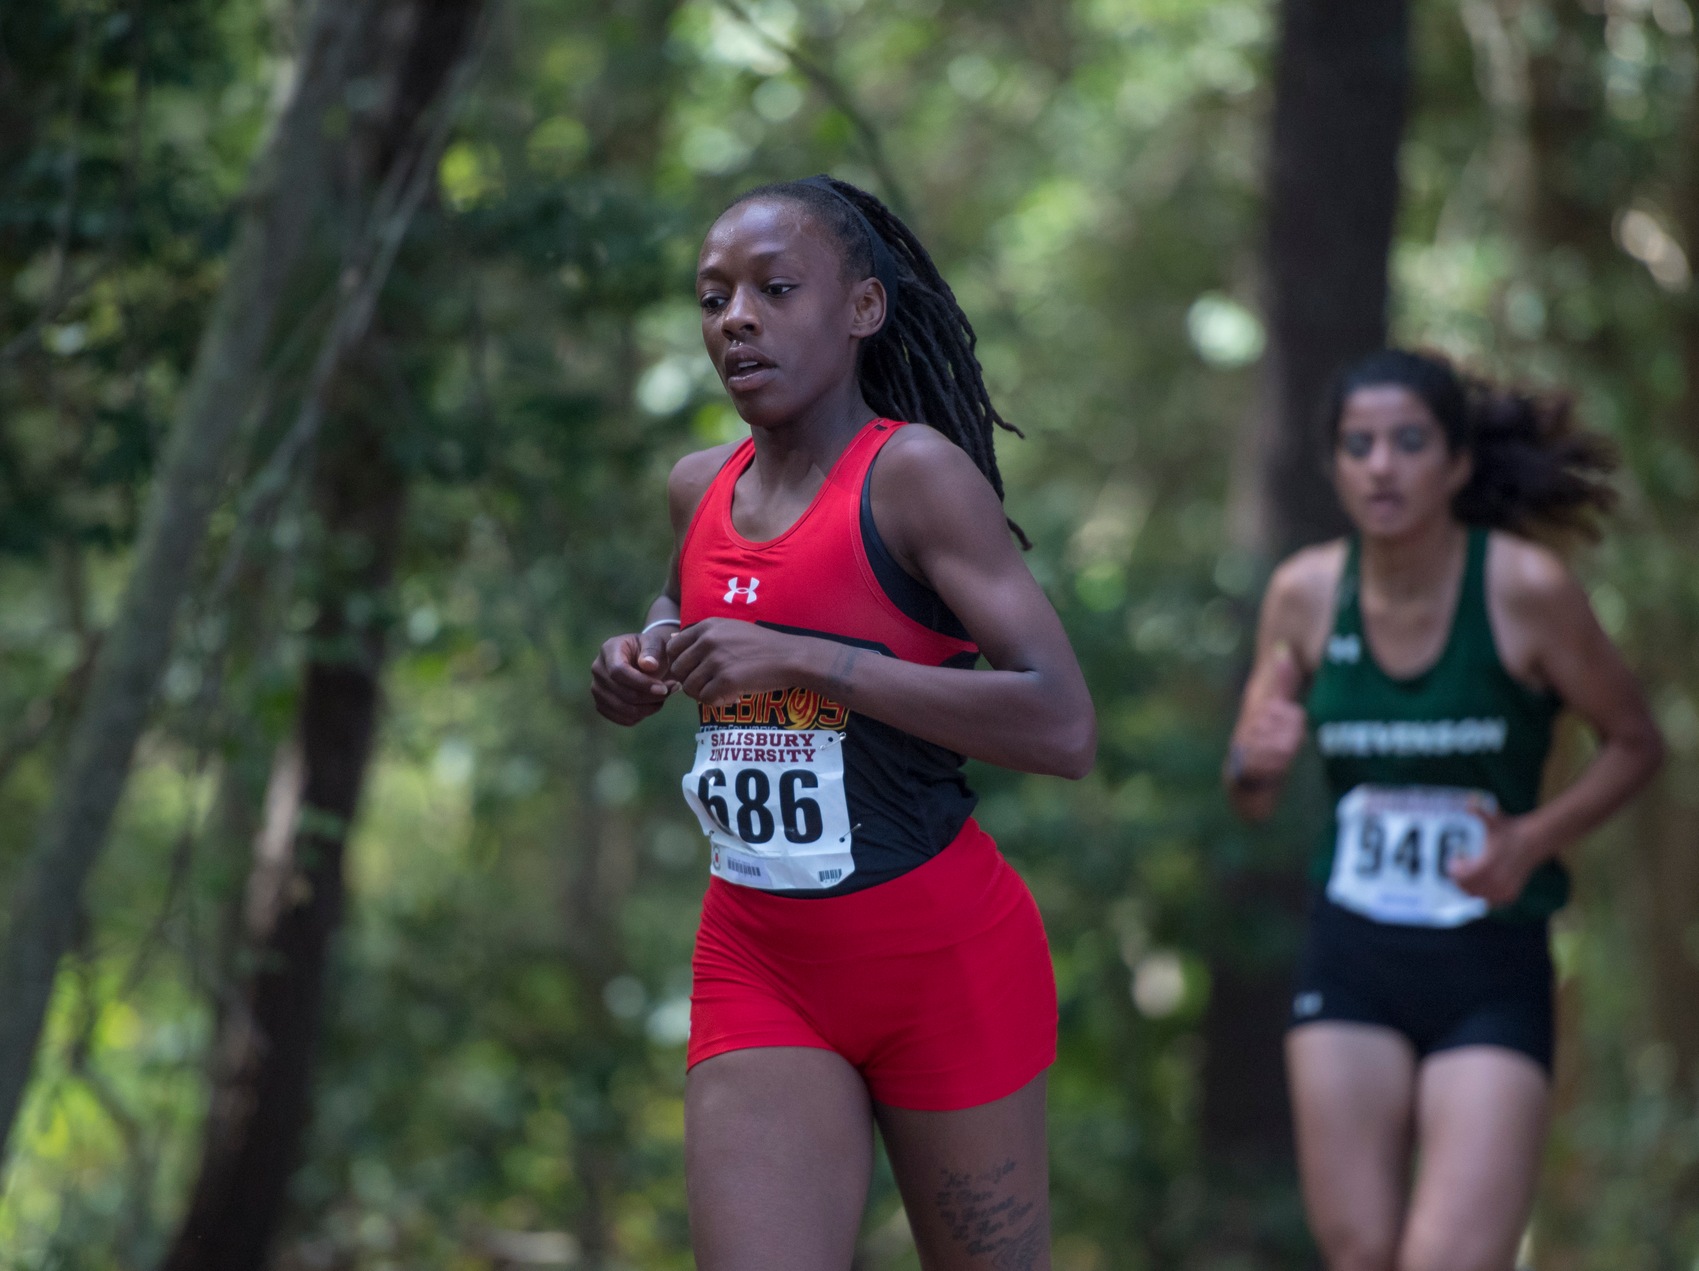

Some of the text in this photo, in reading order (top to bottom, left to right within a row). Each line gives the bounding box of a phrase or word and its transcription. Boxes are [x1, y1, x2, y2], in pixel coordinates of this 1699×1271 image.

[711, 732, 815, 747] SALISBURY
[709, 748, 816, 763] UNIVERSITY
[697, 768, 824, 845] 686
